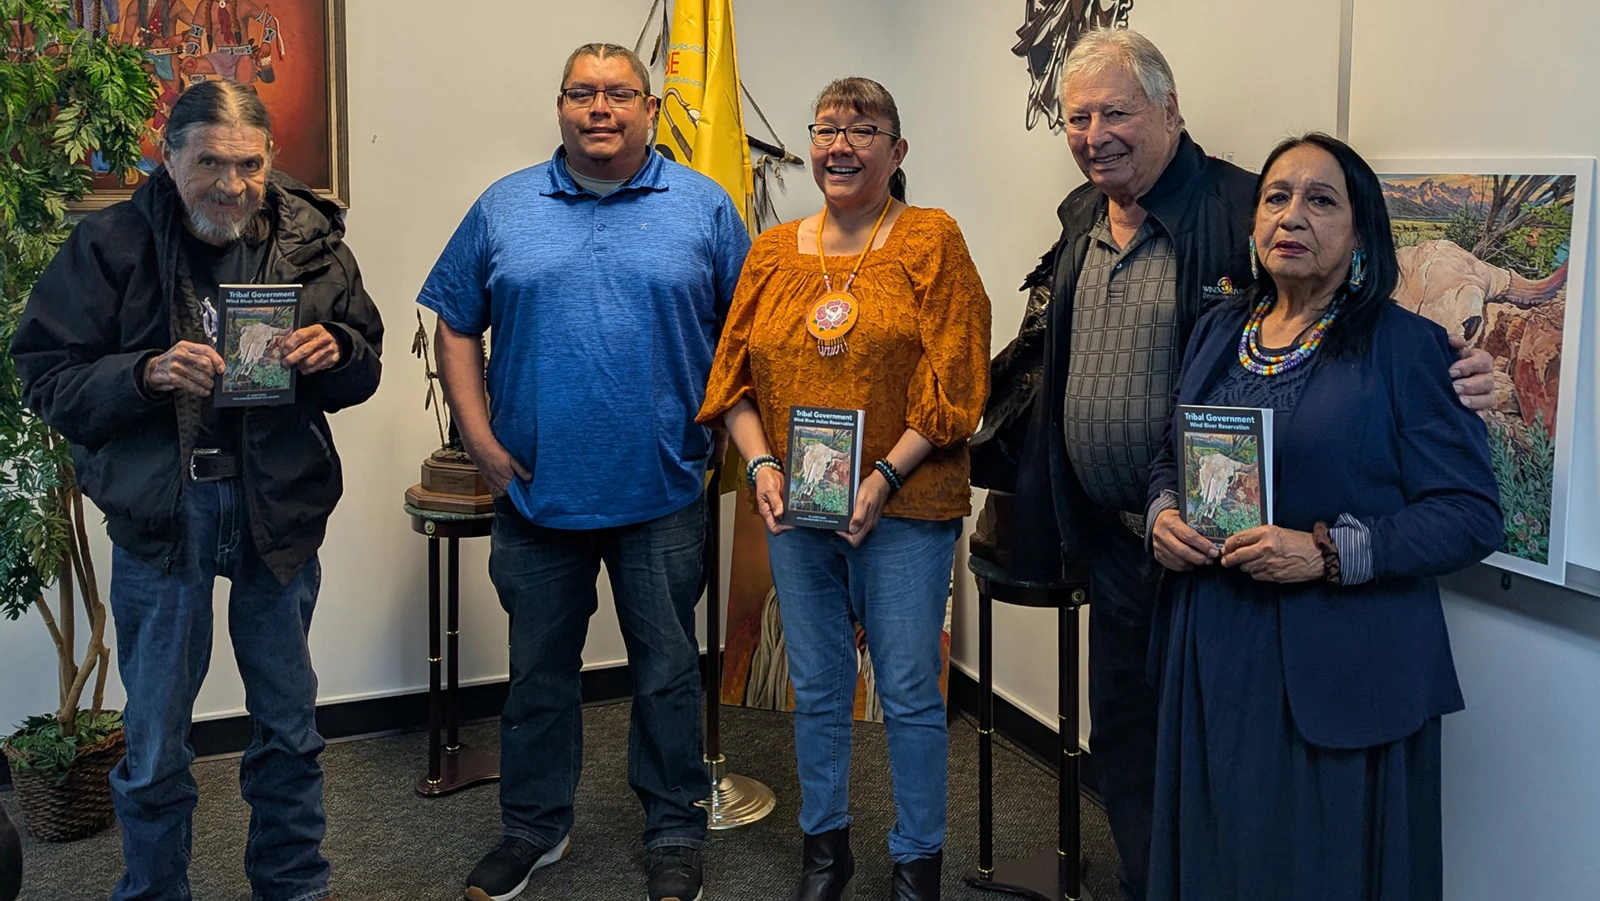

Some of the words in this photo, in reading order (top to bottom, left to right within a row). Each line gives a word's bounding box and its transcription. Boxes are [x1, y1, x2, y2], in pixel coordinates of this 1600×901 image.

[796, 410, 812, 418] Tribal
[813, 411, 853, 420] Government
[1184, 412, 1205, 421] Tribal
[1206, 413, 1256, 424] Government
[1218, 423, 1250, 431] Reservation
